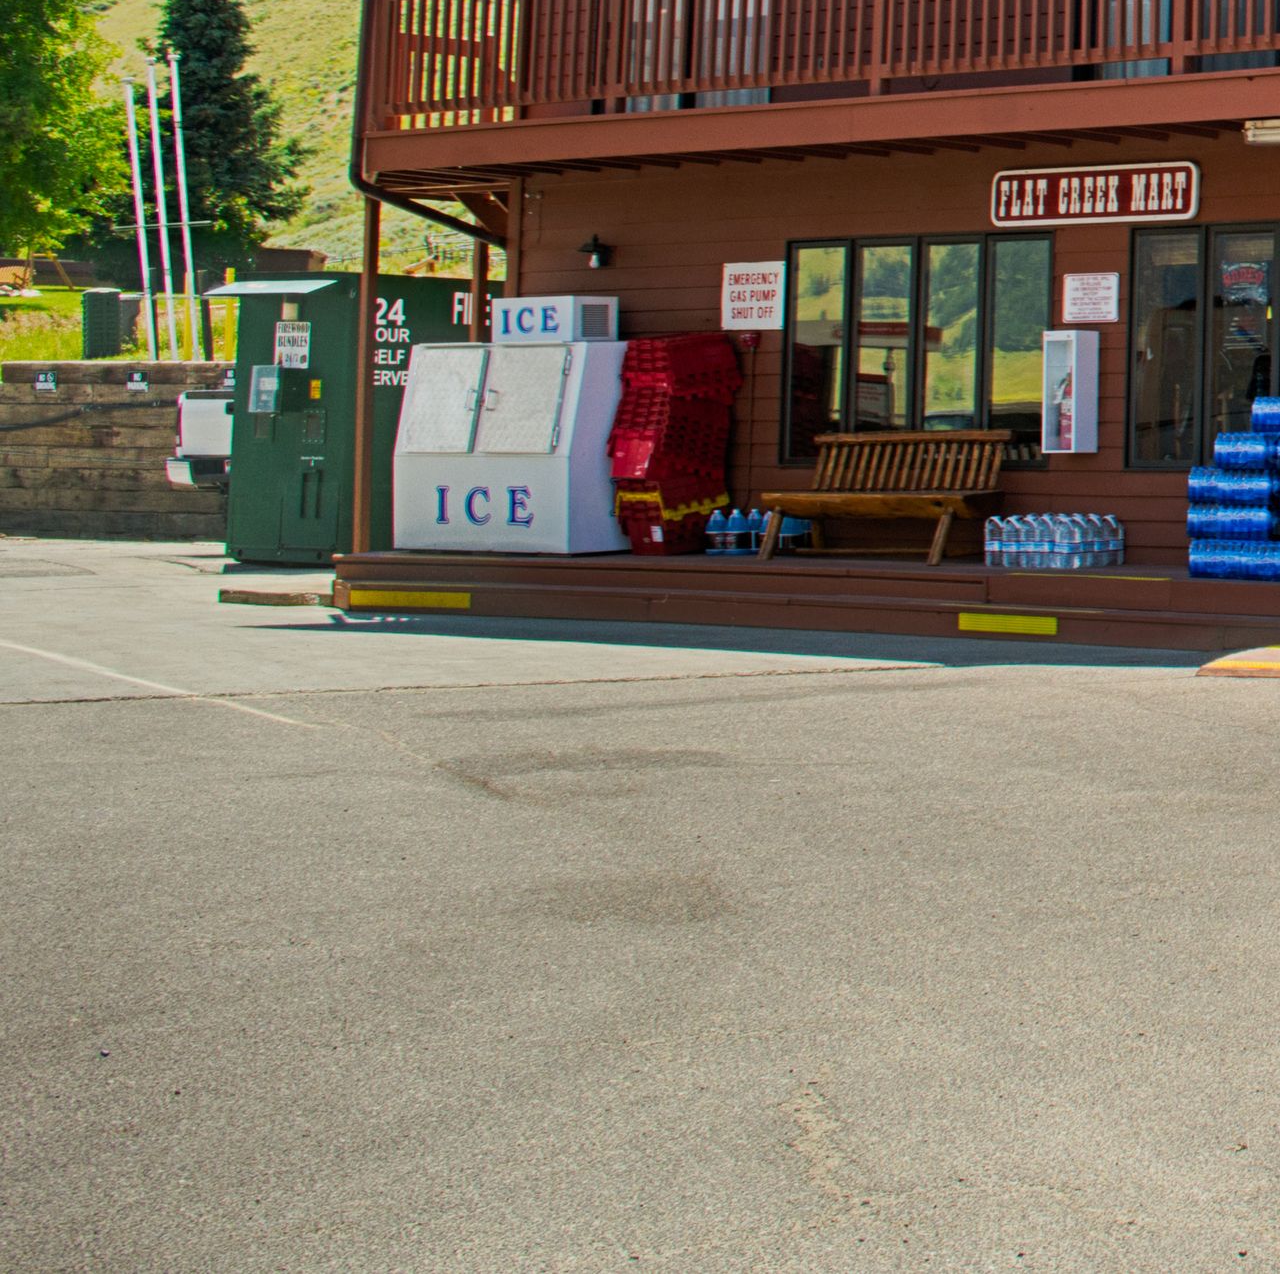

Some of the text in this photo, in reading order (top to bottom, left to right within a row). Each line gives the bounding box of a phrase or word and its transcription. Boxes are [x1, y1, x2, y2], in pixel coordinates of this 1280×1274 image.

[999, 172, 1187, 217] FLAT CREEK MART
[728, 272, 779, 286] EMERGENCY
[730, 289, 777, 302] GAS PUMP
[375, 297, 406, 326] 24
[731, 306, 774, 319] SHUT OFF
[502, 305, 560, 334] ICE
[278, 335, 308, 347] BUNDLES
[374, 327, 410, 342] OUR
[373, 349, 406, 365] ELF
[436, 485, 534, 528] ICE
